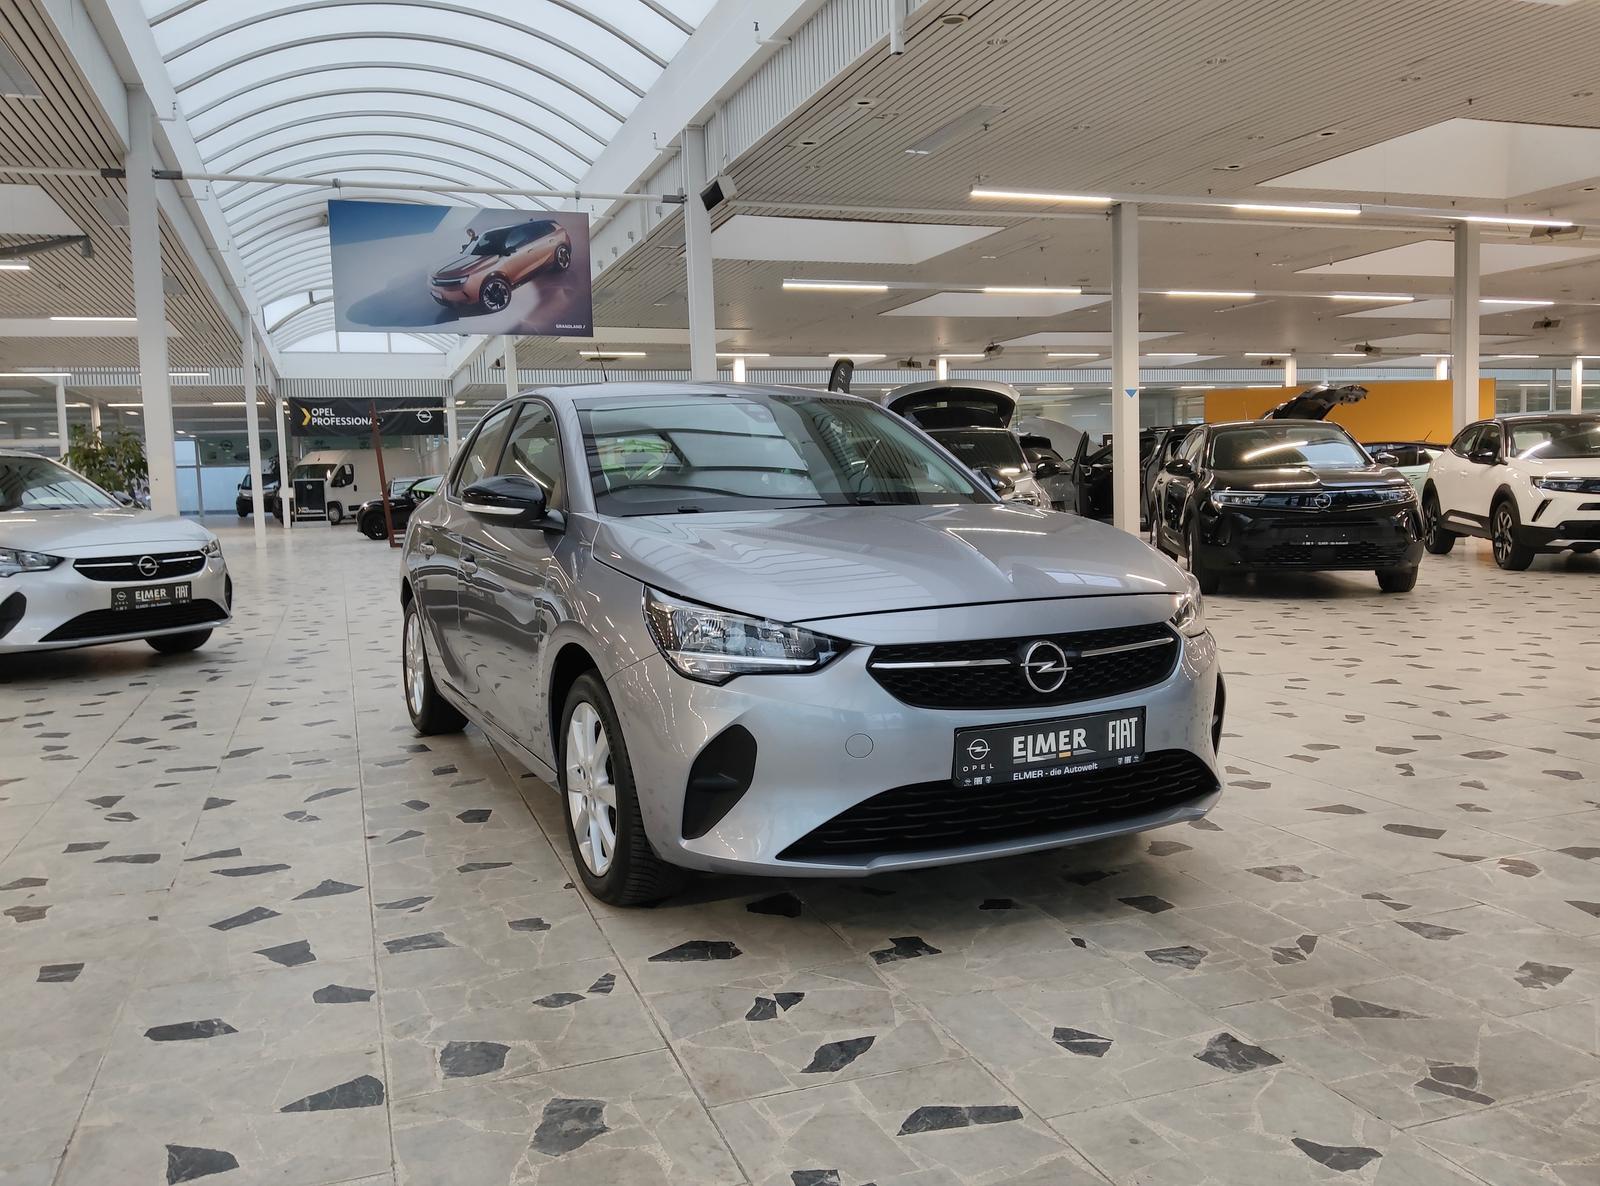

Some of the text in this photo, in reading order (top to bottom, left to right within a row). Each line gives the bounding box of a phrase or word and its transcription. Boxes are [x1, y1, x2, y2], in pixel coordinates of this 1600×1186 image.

[311, 407, 335, 417] OPEL
[135, 588, 167, 602] ELMER
[175, 585, 189, 599] FIAT
[1108, 717, 1138, 751] FIAT
[1013, 728, 1087, 762] ELMER
[963, 763, 994, 772] OPEL
[1013, 769, 1044, 781] ELMER
[1050, 768, 1062, 776] die
[1063, 762, 1098, 775] Autowelt
